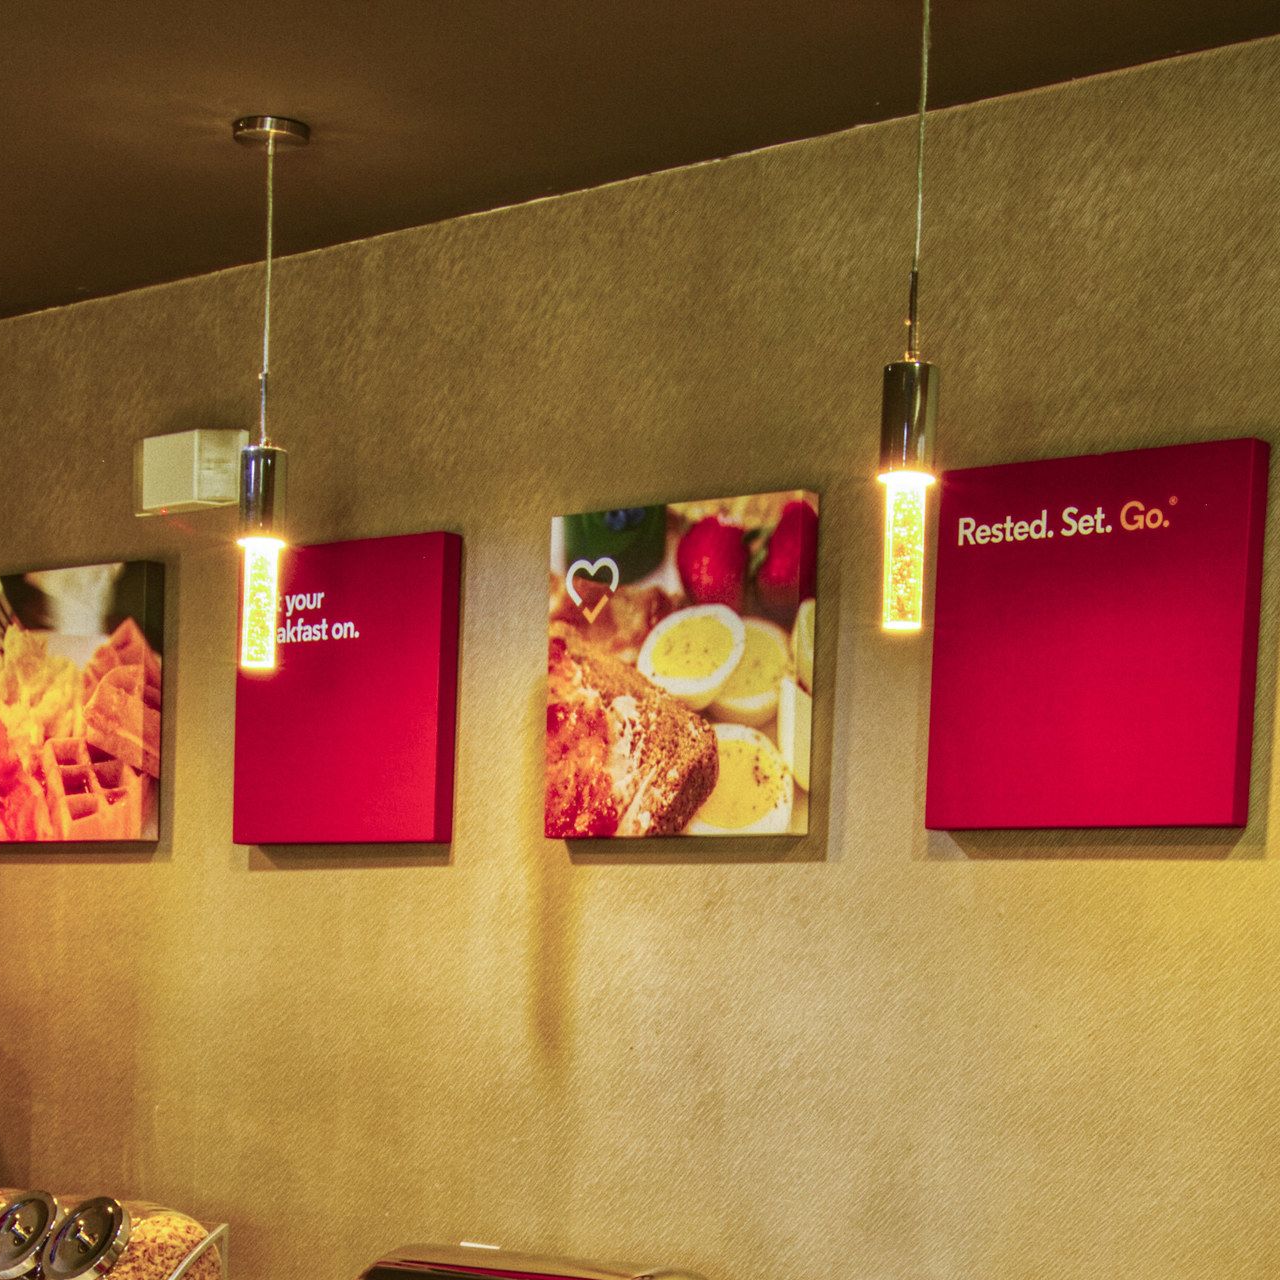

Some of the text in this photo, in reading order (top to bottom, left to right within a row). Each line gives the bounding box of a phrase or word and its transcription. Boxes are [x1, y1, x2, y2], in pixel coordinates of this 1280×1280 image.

[957, 509, 1054, 547] Rested.
[1060, 506, 1113, 538] Set.
[285, 591, 325, 616] your
[276, 617, 360, 644] akfast on.
